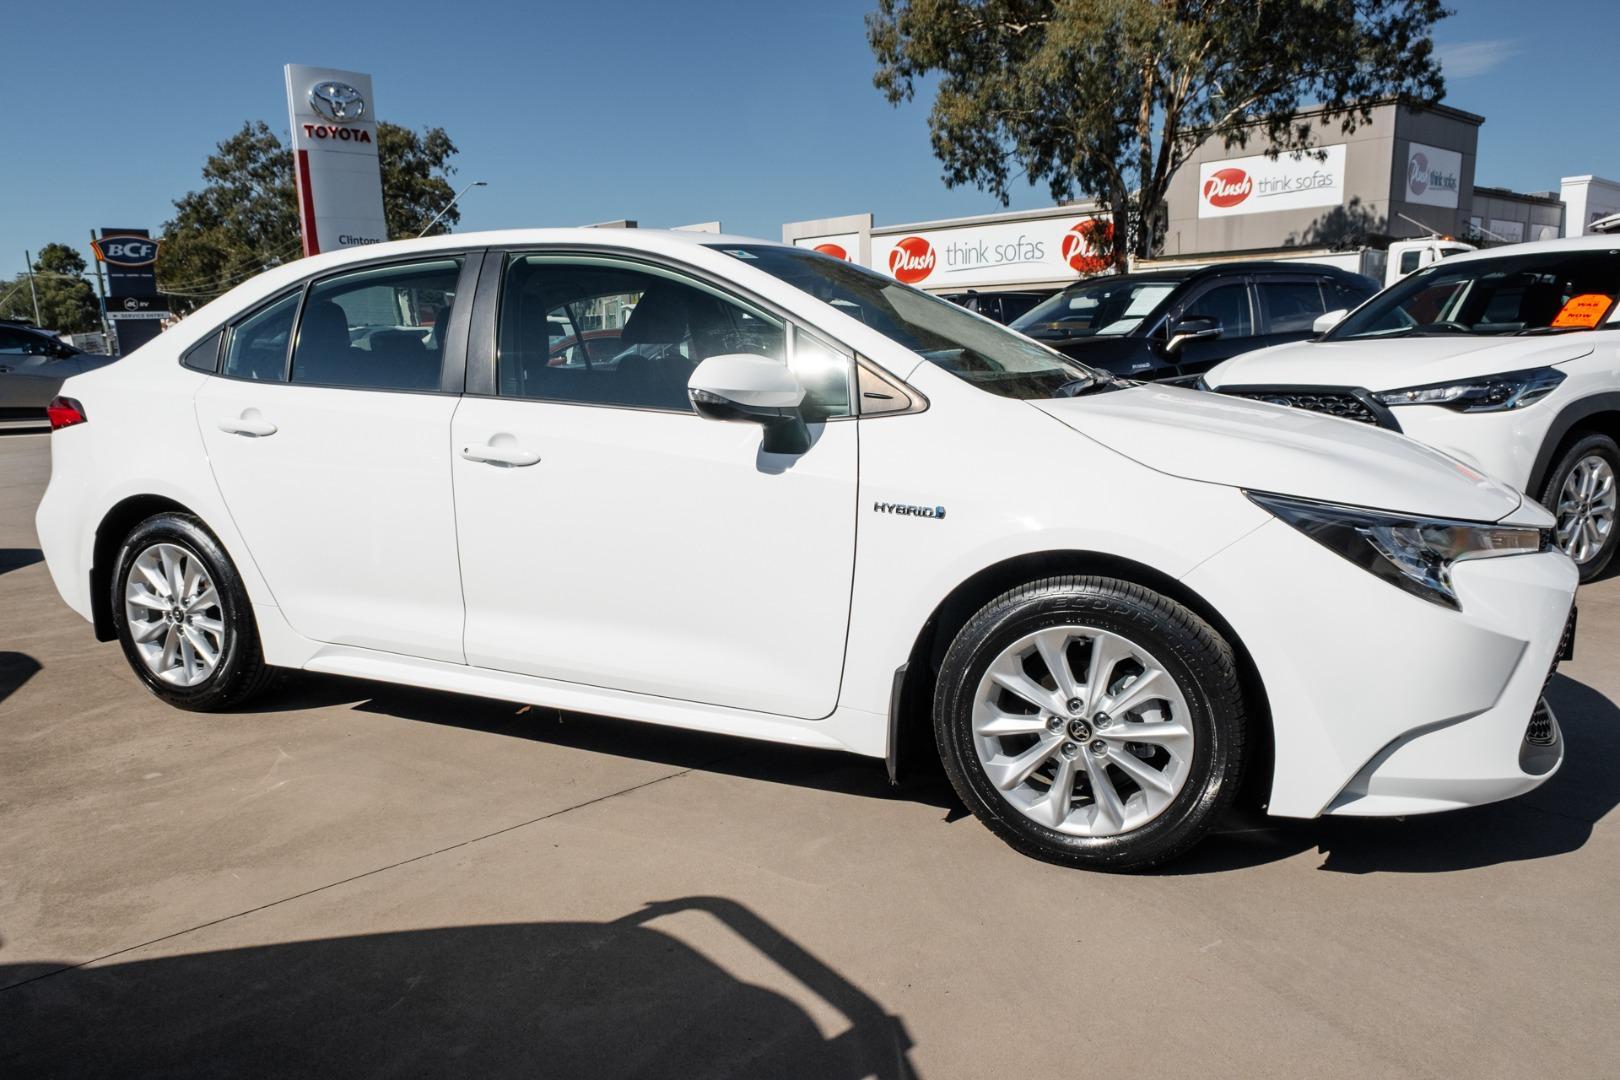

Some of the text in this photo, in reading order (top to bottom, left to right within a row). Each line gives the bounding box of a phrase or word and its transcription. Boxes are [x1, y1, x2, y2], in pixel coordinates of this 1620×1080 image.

[303, 125, 371, 143] TOYOTA
[1206, 170, 1333, 201] Plush think sofas
[338, 235, 381, 246] Clintons
[107, 242, 152, 257] BCF
[891, 241, 937, 278] Plush
[945, 239, 989, 266] think
[994, 235, 1045, 263] sofas
[873, 501, 935, 518] HYBRID
